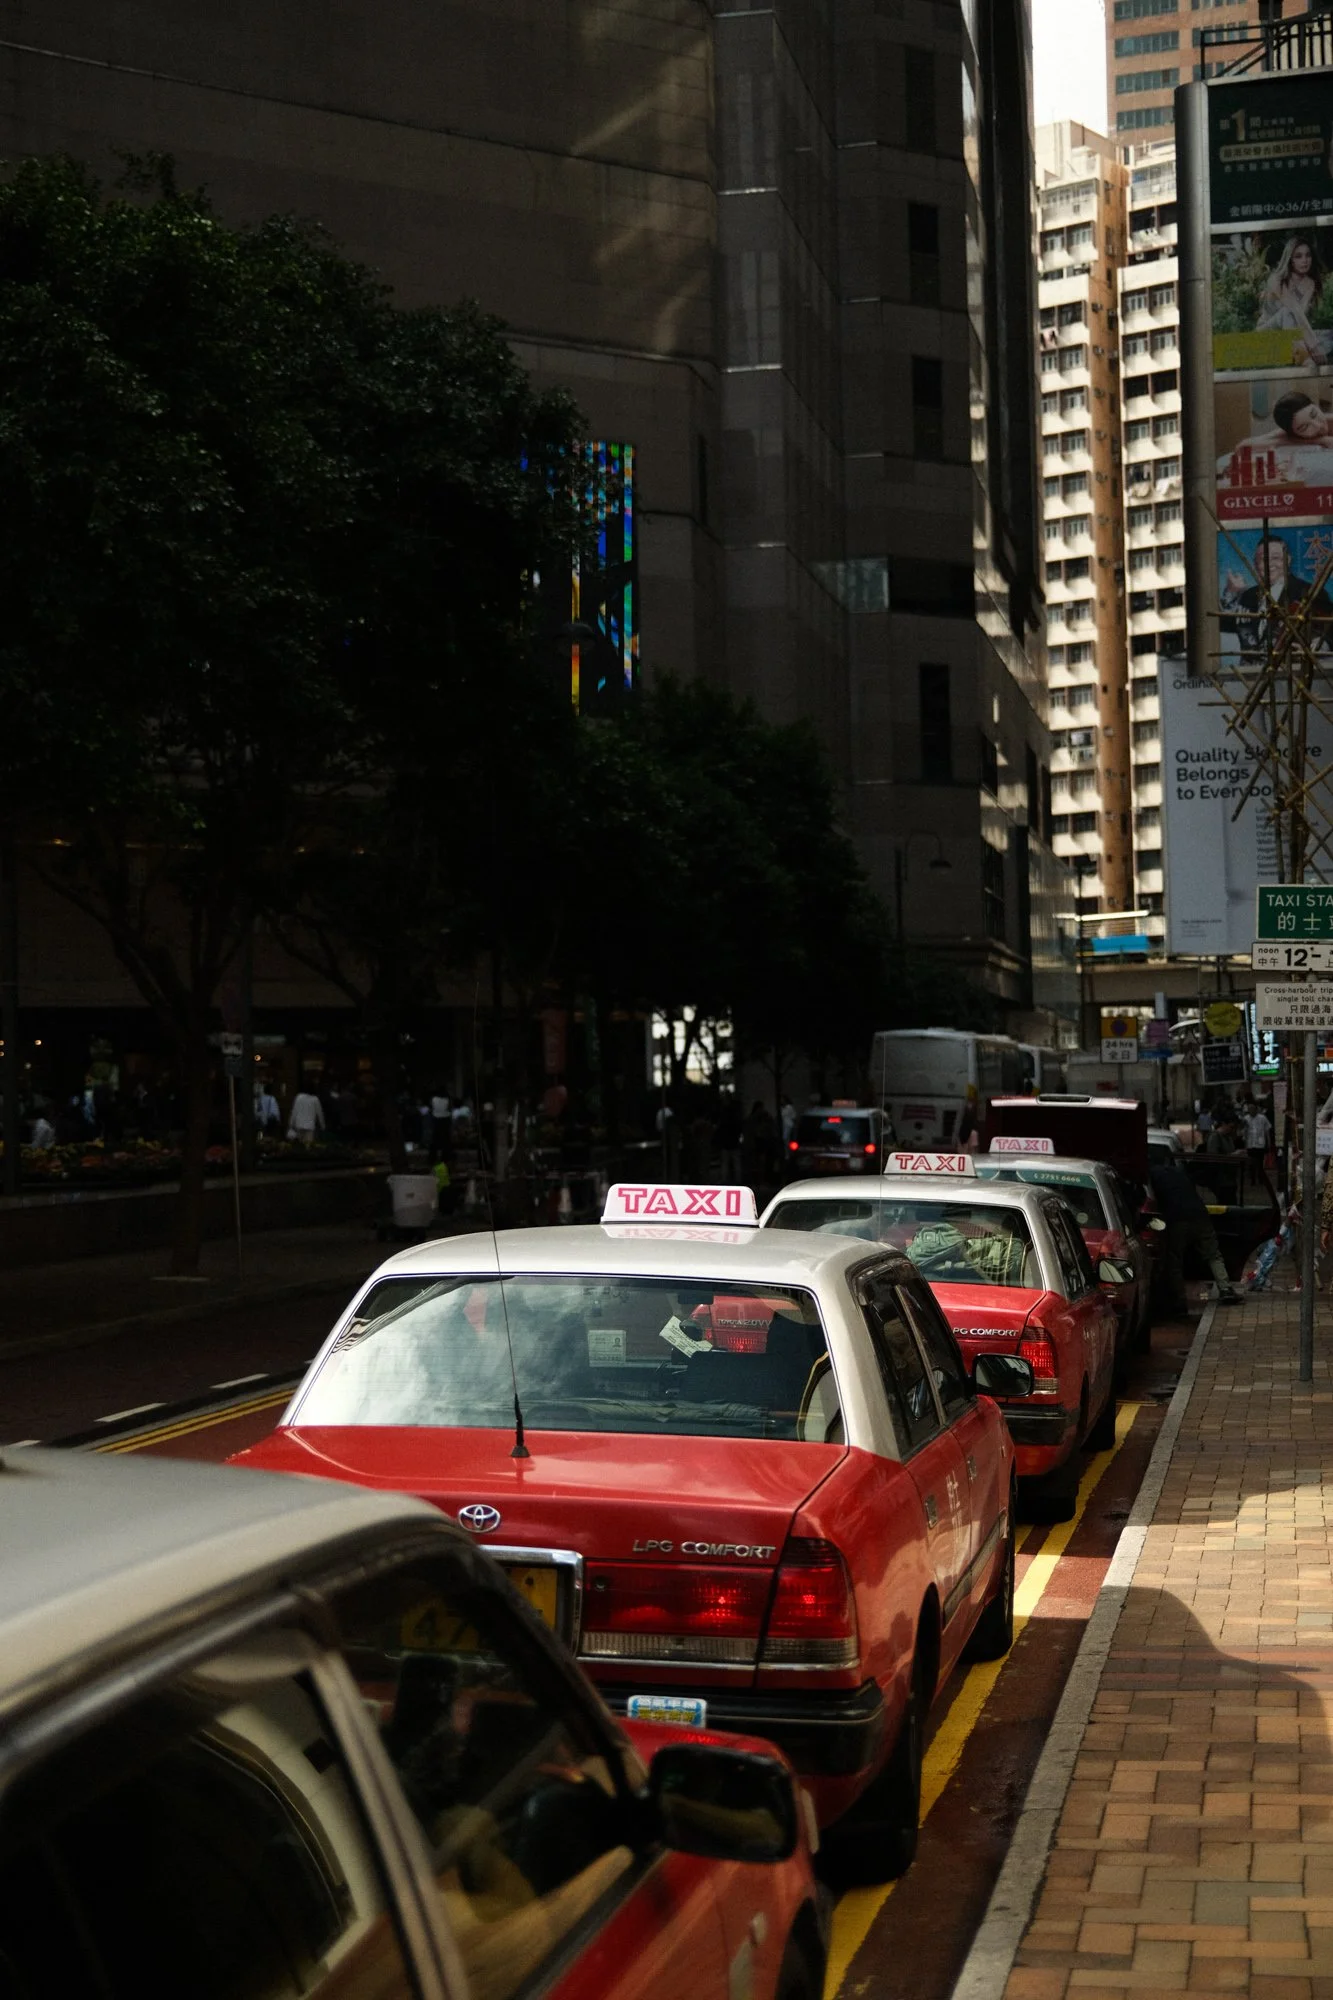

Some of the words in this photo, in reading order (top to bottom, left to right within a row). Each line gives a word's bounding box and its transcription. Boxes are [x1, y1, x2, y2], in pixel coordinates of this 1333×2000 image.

[1223, 495, 1281, 509] GLYCEL
[1175, 748, 1239, 765] Quality
[1176, 766, 1250, 783] Belongs
[1177, 787, 1195, 801] to
[1266, 894, 1300, 907] TAXI
[1277, 911, 1333, 932] 的士
[1258, 957, 1279, 967] 中午
[1285, 948, 1308, 967] 12
[1264, 986, 1317, 994] Cross-harbour
[1290, 1004, 1331, 1015] 只限過海
[1105, 1040, 1117, 1049] 24
[1119, 1040, 1133, 1049] hrs
[1108, 1050, 1130, 1061] 全日
[995, 1138, 1049, 1153] TAXI
[895, 1154, 966, 1173] TAXI
[618, 1187, 742, 1216] TAXI
[970, 1327, 1019, 1337] COMFORT
[633, 1539, 674, 1553] LPG
[681, 1541, 777, 1559] COMFORT
